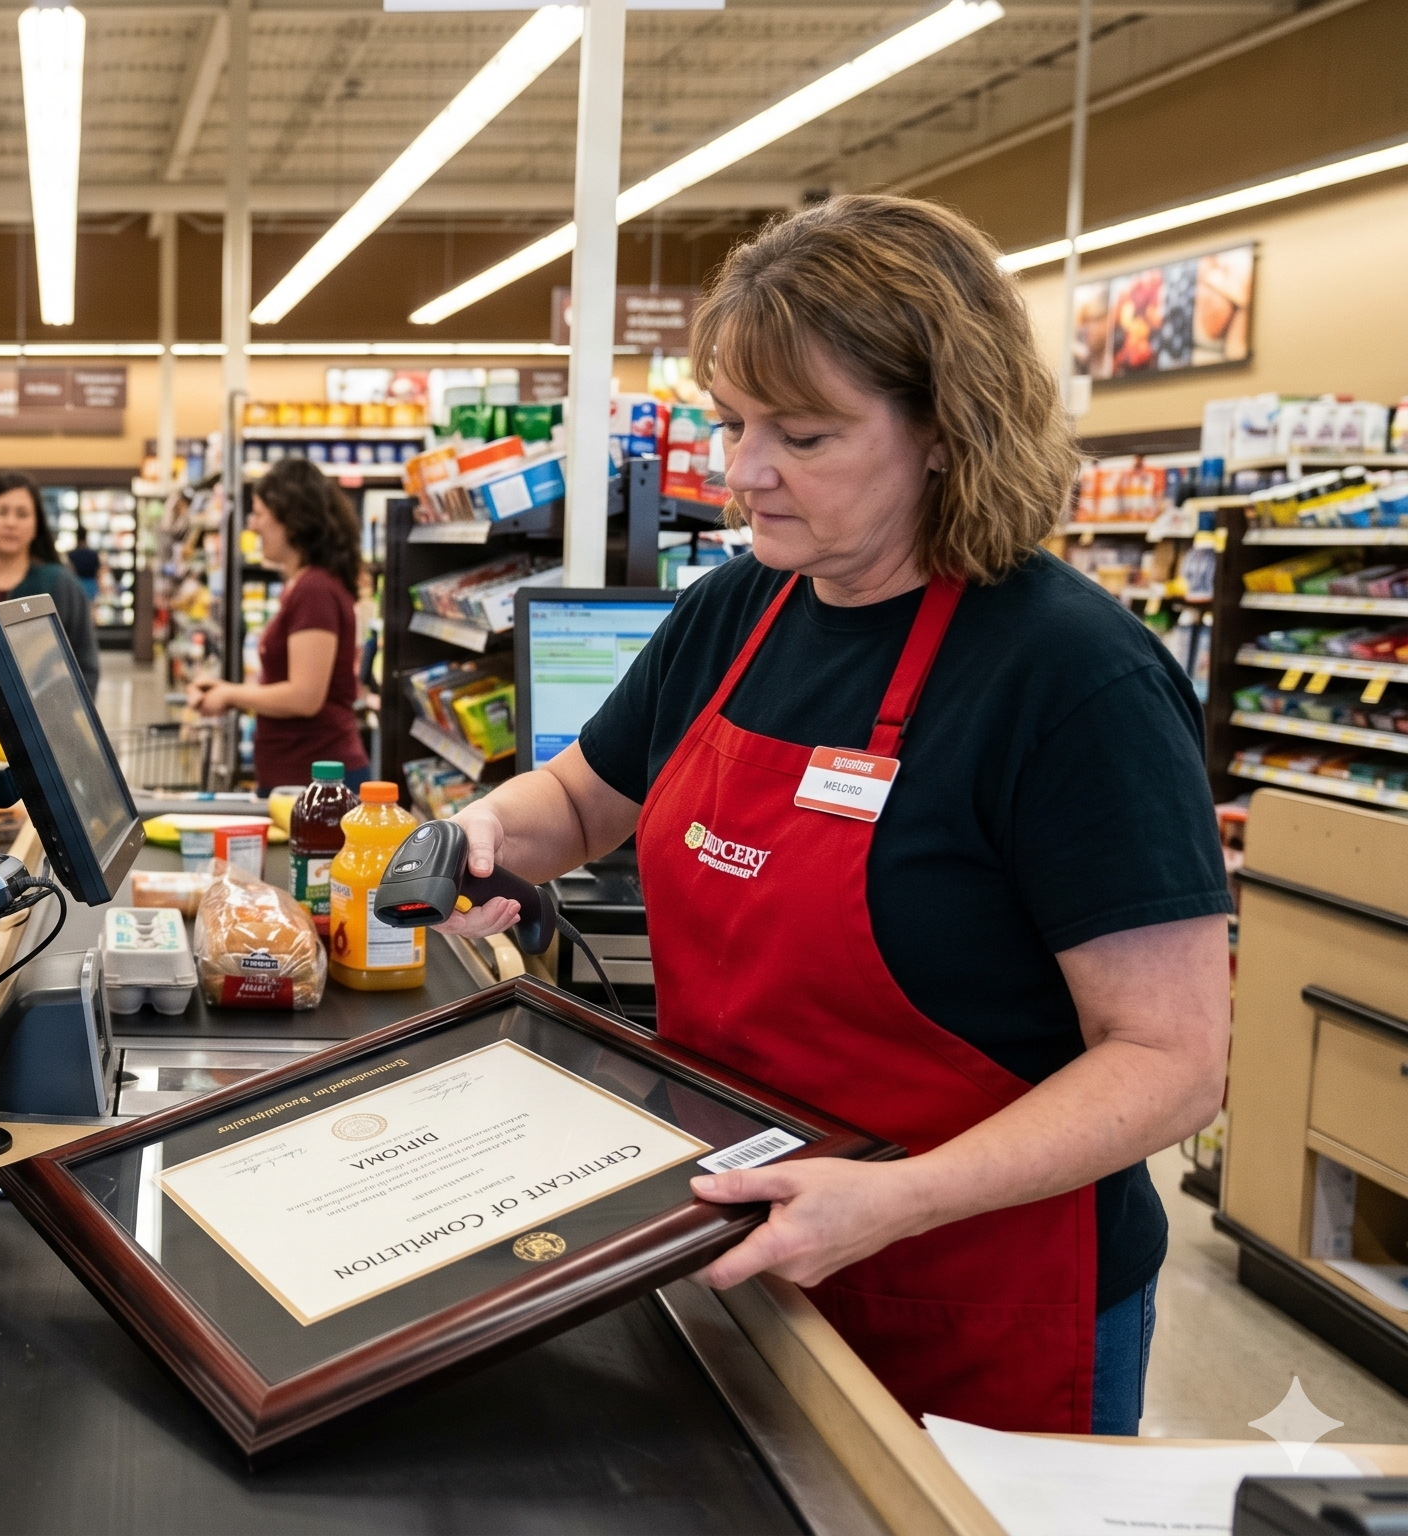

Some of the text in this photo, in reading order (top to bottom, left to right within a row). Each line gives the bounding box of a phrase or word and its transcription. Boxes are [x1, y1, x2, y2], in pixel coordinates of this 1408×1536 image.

[349, 1132, 440, 1170] DIPLOMA
[521, 1145, 642, 1200] CERTIFICATE
[489, 1198, 519, 1218] OF
